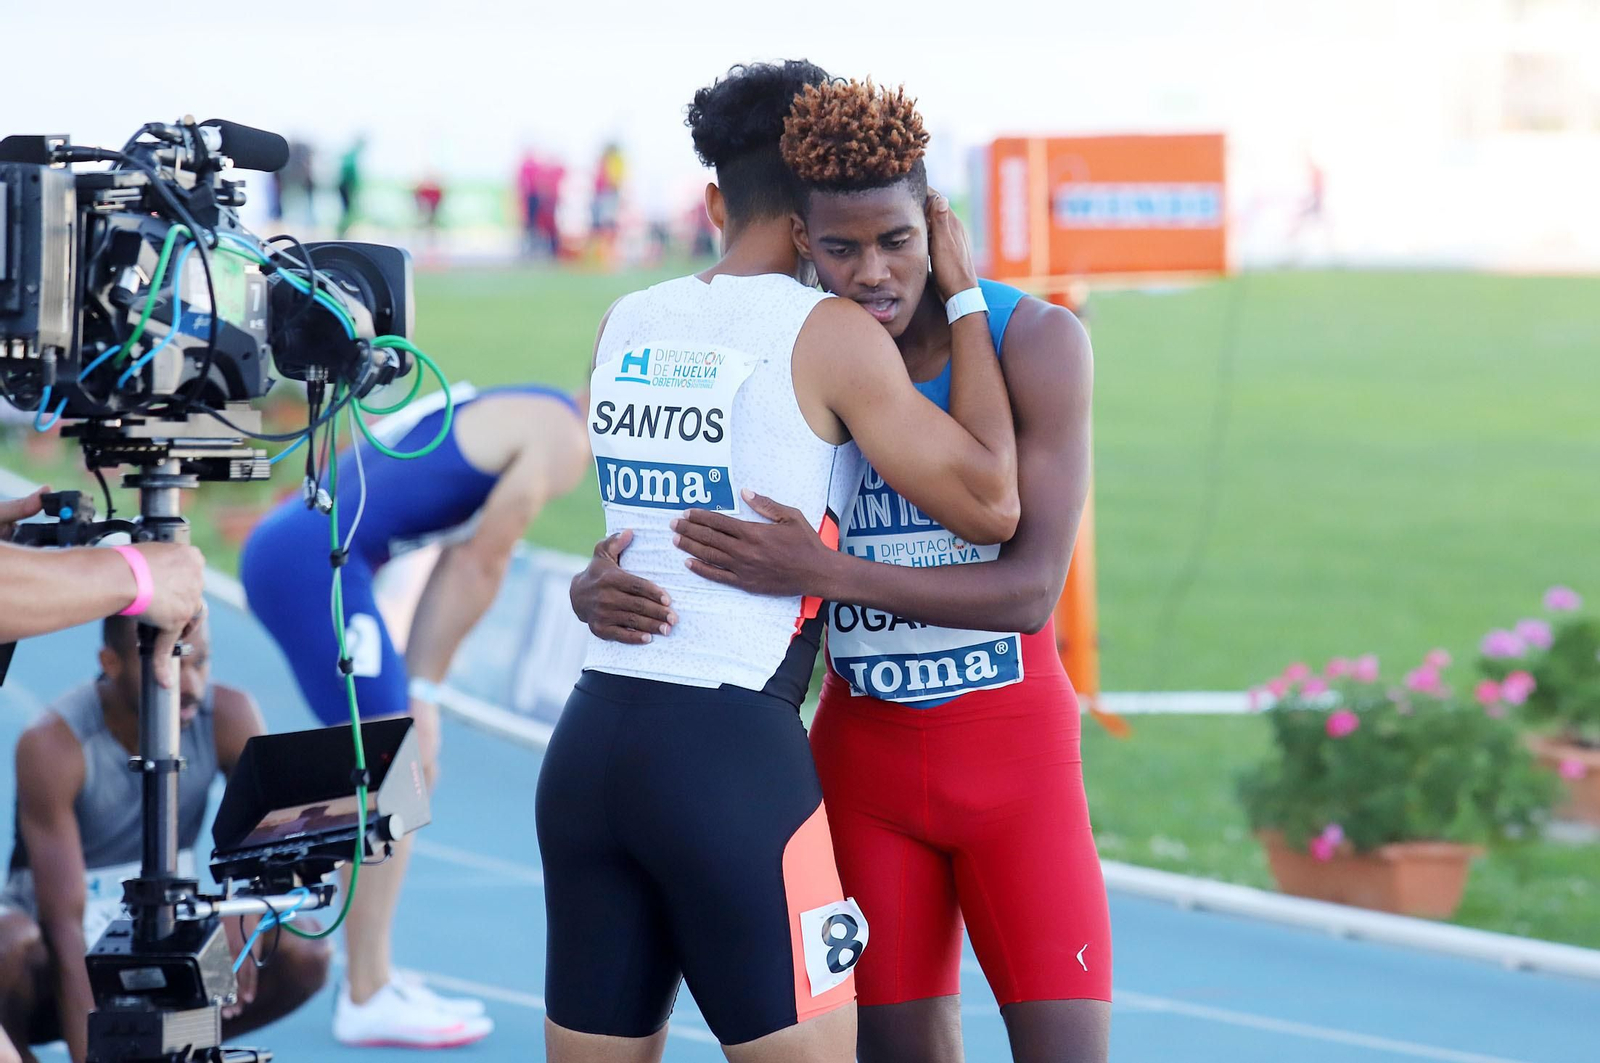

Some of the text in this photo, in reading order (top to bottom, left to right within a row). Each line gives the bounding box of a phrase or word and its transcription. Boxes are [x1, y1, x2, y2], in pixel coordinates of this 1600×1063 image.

[652, 377, 692, 389] OBJETIVOS
[653, 363, 717, 379] DE HUELVA
[592, 400, 724, 443] SANTOS
[911, 548, 980, 569] HUELVA
[834, 602, 927, 633] OGA
[821, 913, 863, 973] 8
